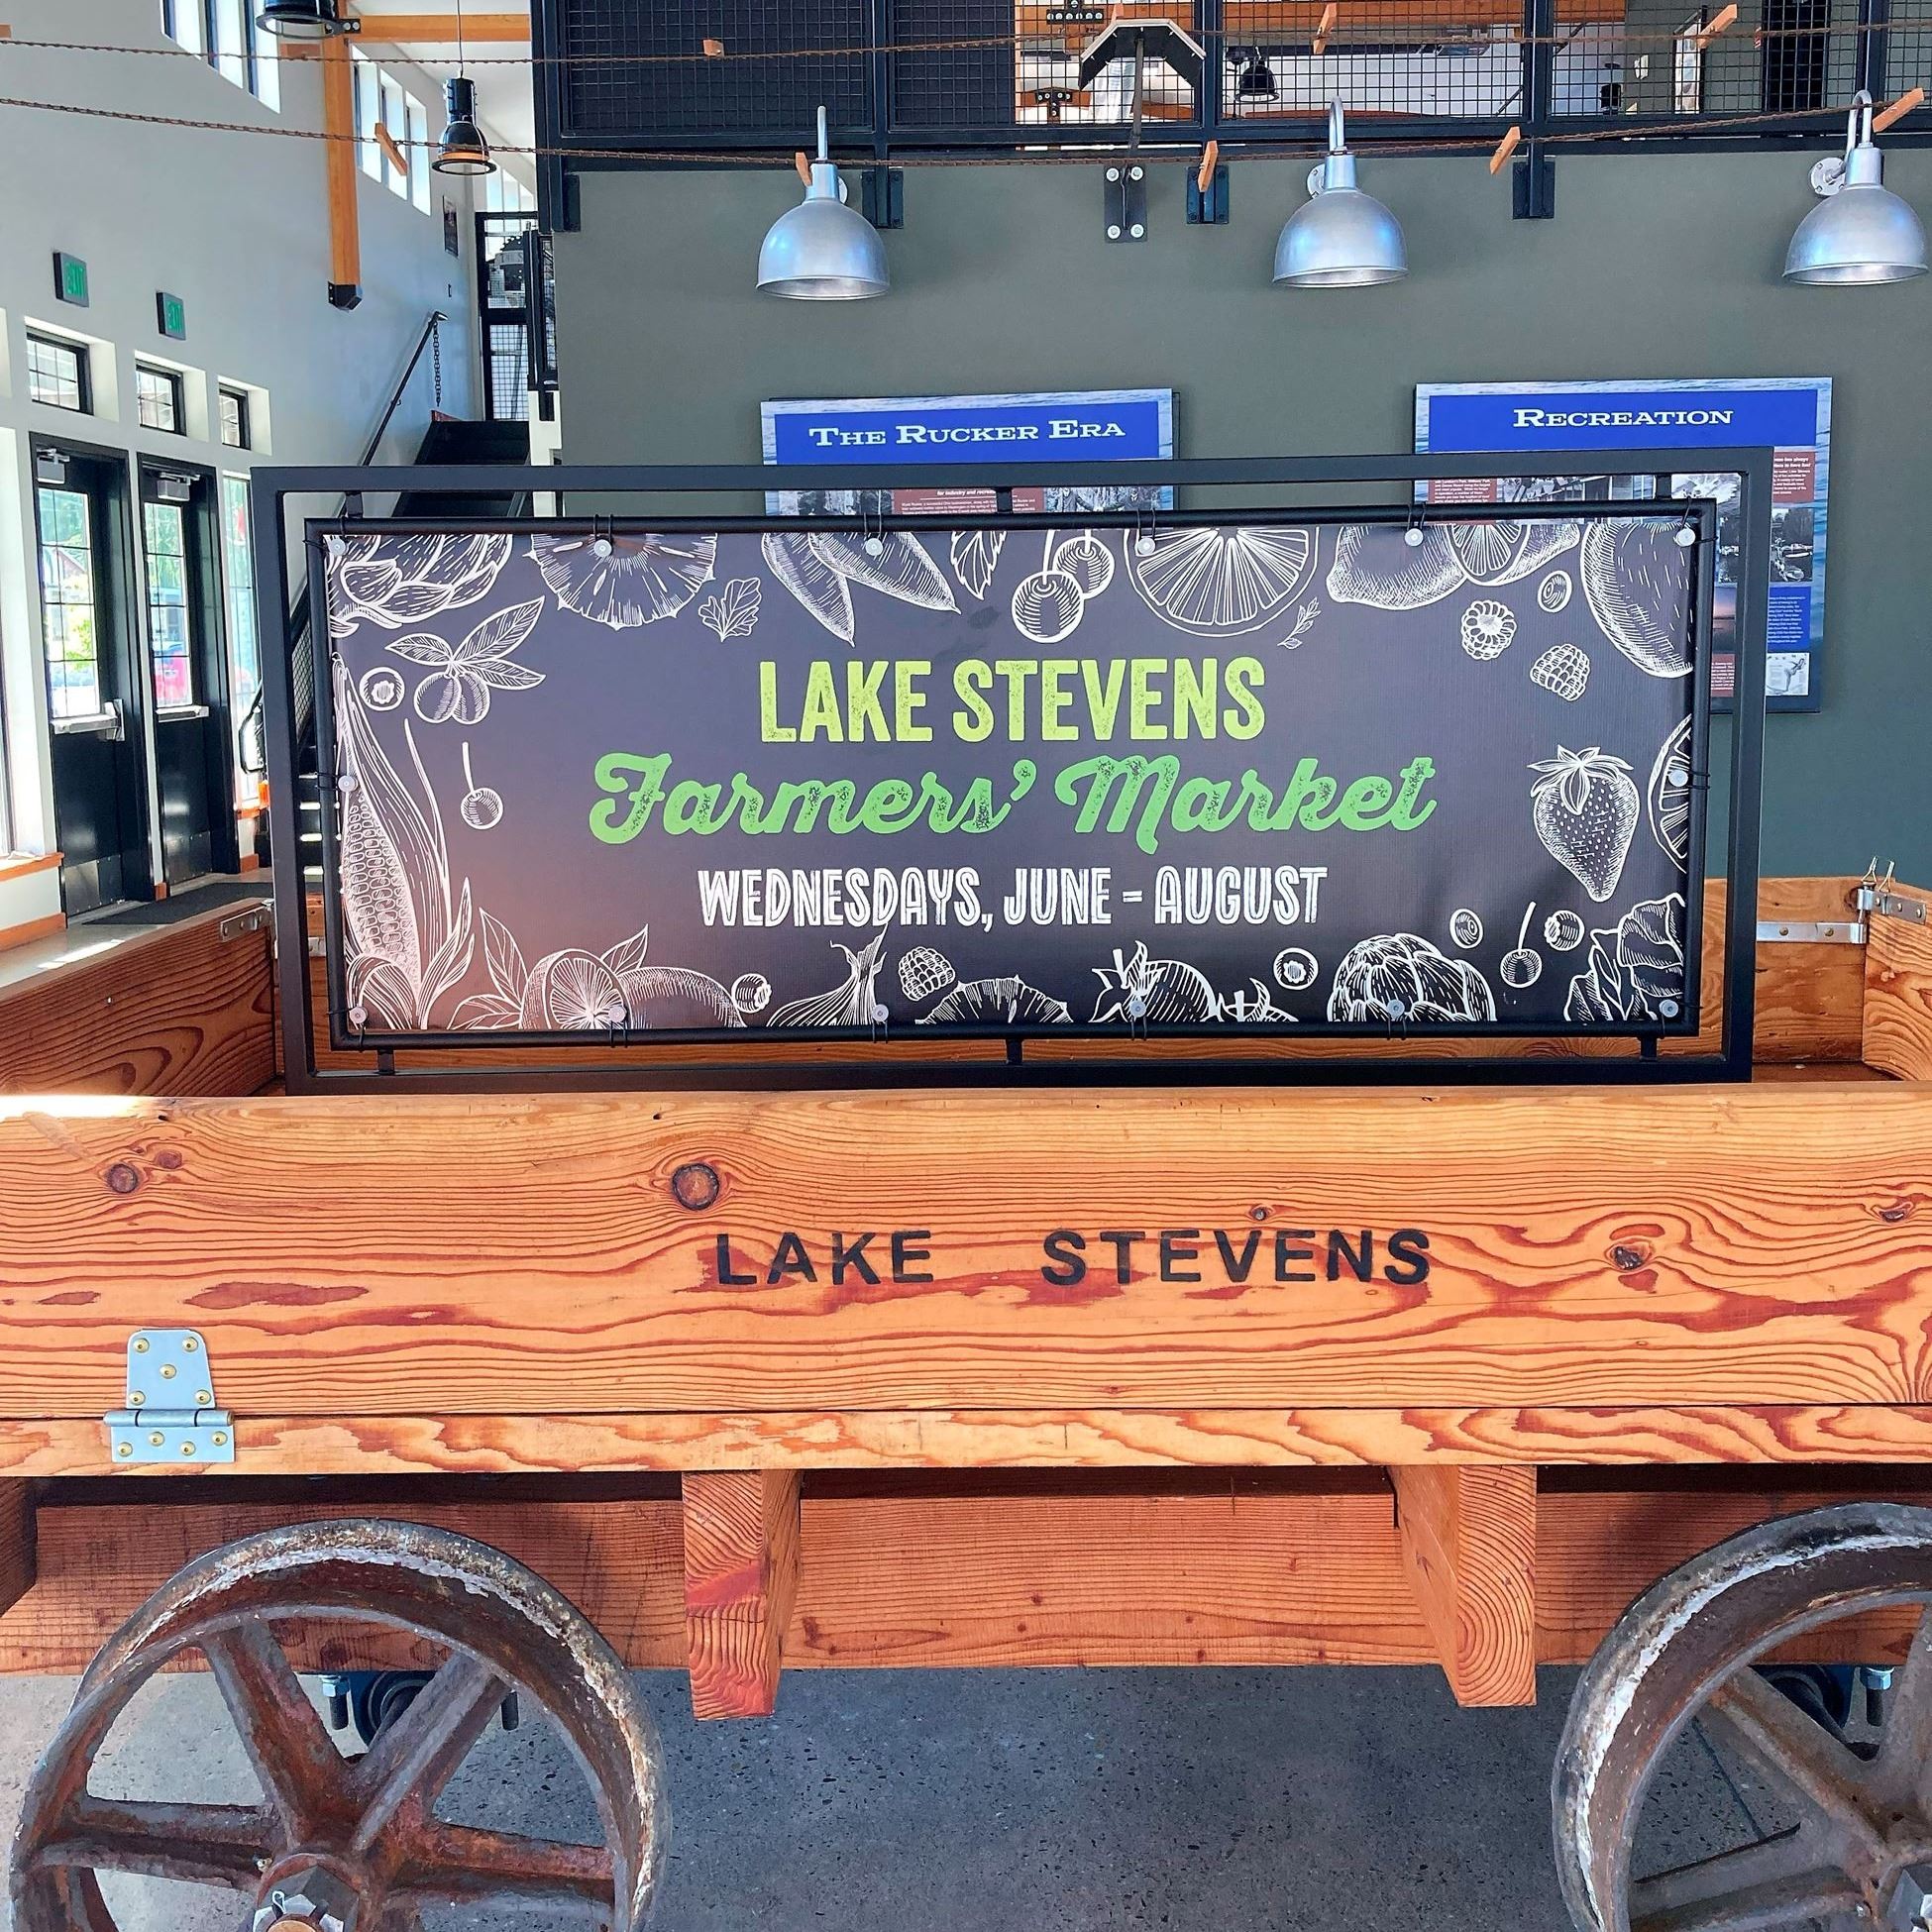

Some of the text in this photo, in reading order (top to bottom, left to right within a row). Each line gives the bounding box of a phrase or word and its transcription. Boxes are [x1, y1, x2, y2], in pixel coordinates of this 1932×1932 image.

[759, 656, 1266, 743] LAKE STEVENS
[589, 752, 1439, 856] Farmers' Market
[697, 866, 994, 933] WEDNESDAYS,
[1003, 866, 1113, 925] JUNE
[1153, 865, 1329, 925] AUGUST
[715, 1227, 1431, 1287] LAKE STEVENS
